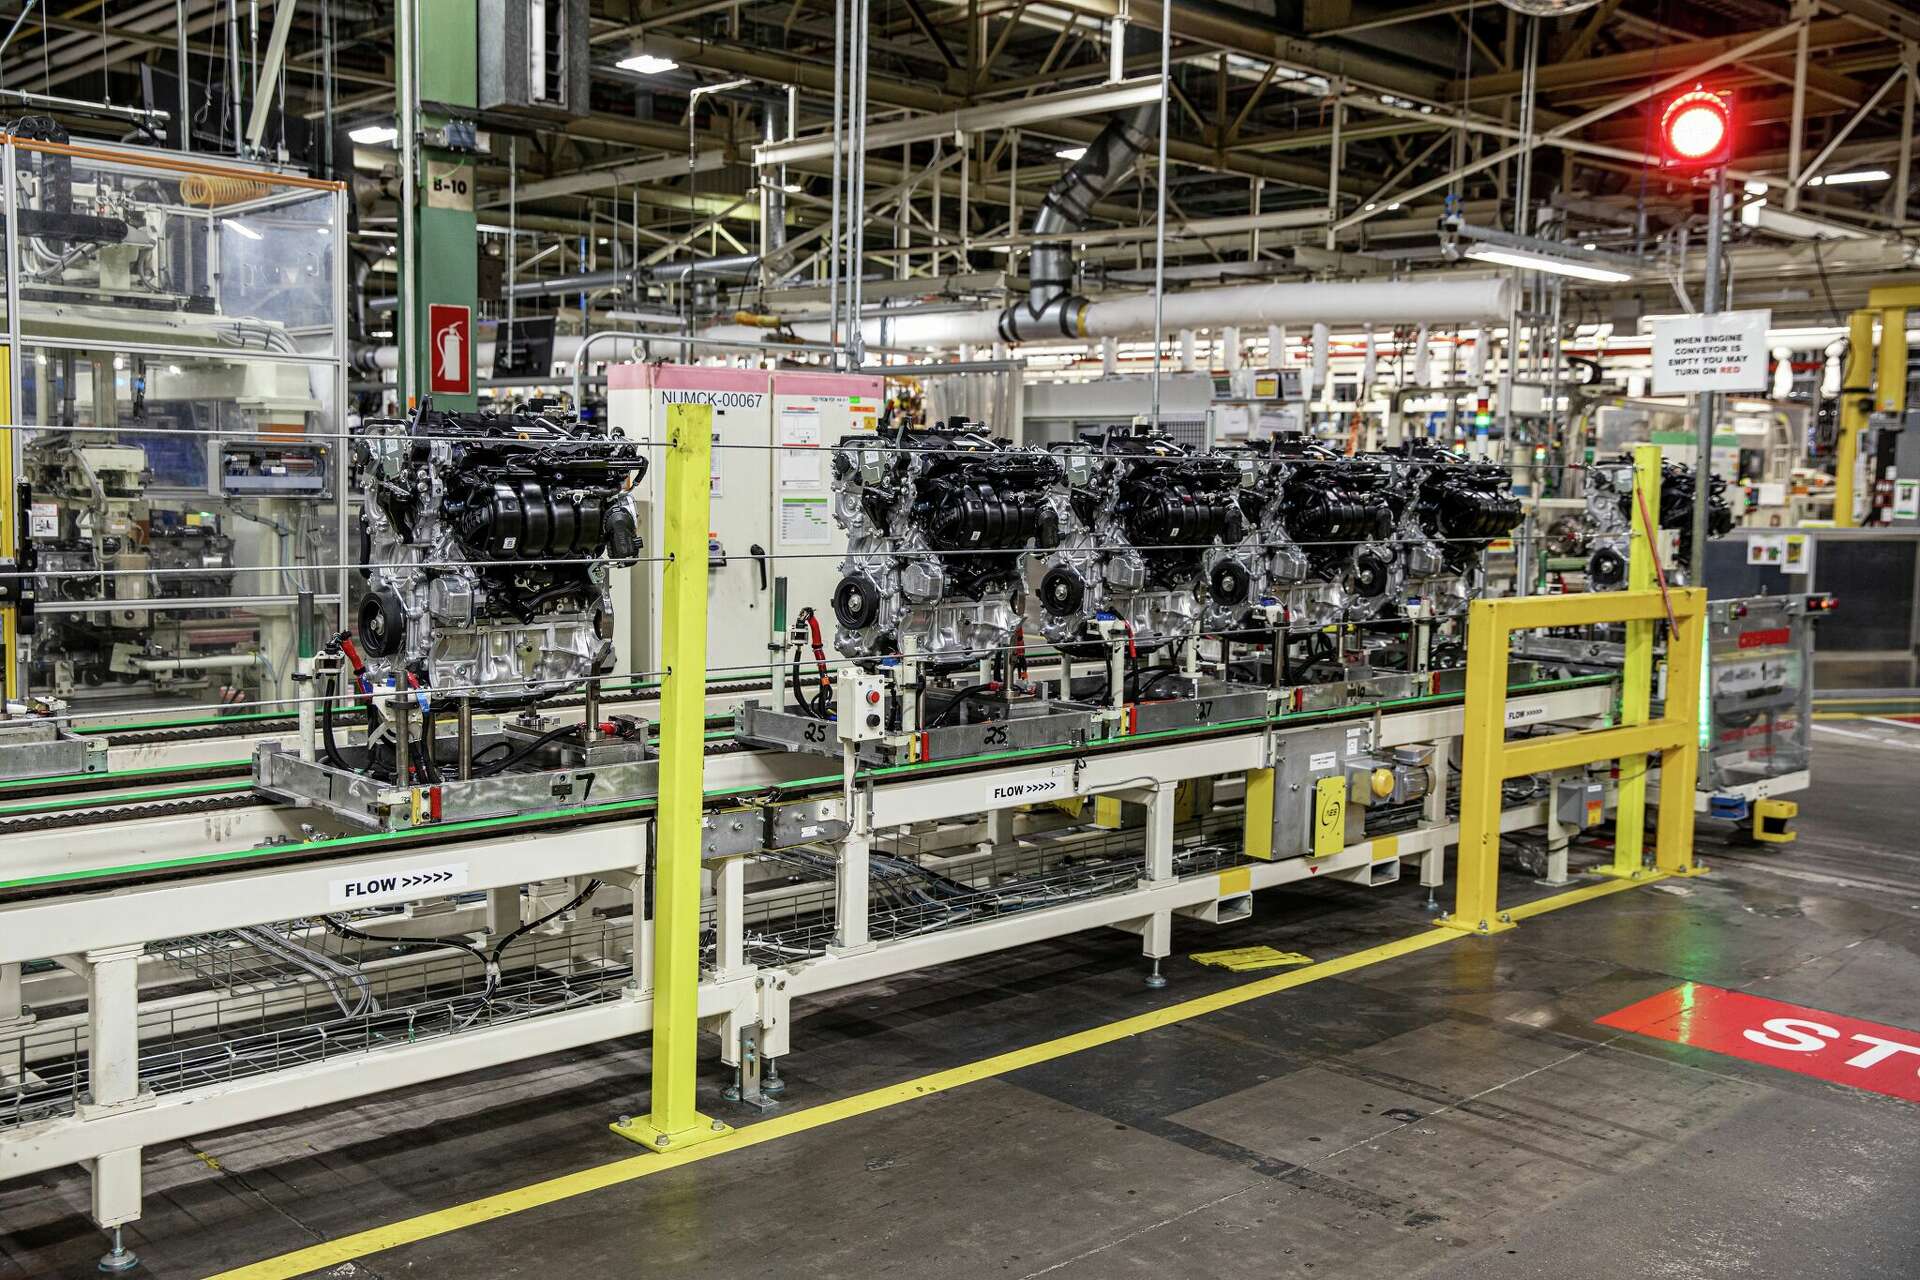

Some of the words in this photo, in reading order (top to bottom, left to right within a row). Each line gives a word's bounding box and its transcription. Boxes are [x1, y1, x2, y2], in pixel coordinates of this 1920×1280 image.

[433, 176, 467, 195] B-10
[1704, 334, 1743, 343] ENGINE
[1674, 346, 1728, 355] CONVEYOR
[1668, 358, 1699, 366] EMPTY
[1726, 355, 1748, 363] MAY
[1674, 368, 1699, 376] TURN
[662, 391, 762, 408] NUMCK-00067
[1508, 710, 1525, 720] FLOW
[804, 722, 827, 743] 25
[983, 724, 1009, 745] 25
[575, 772, 596, 801] 7
[994, 784, 1024, 799] FLOW
[345, 877, 397, 898] FLOW
[1743, 1018, 1920, 1080] ST
